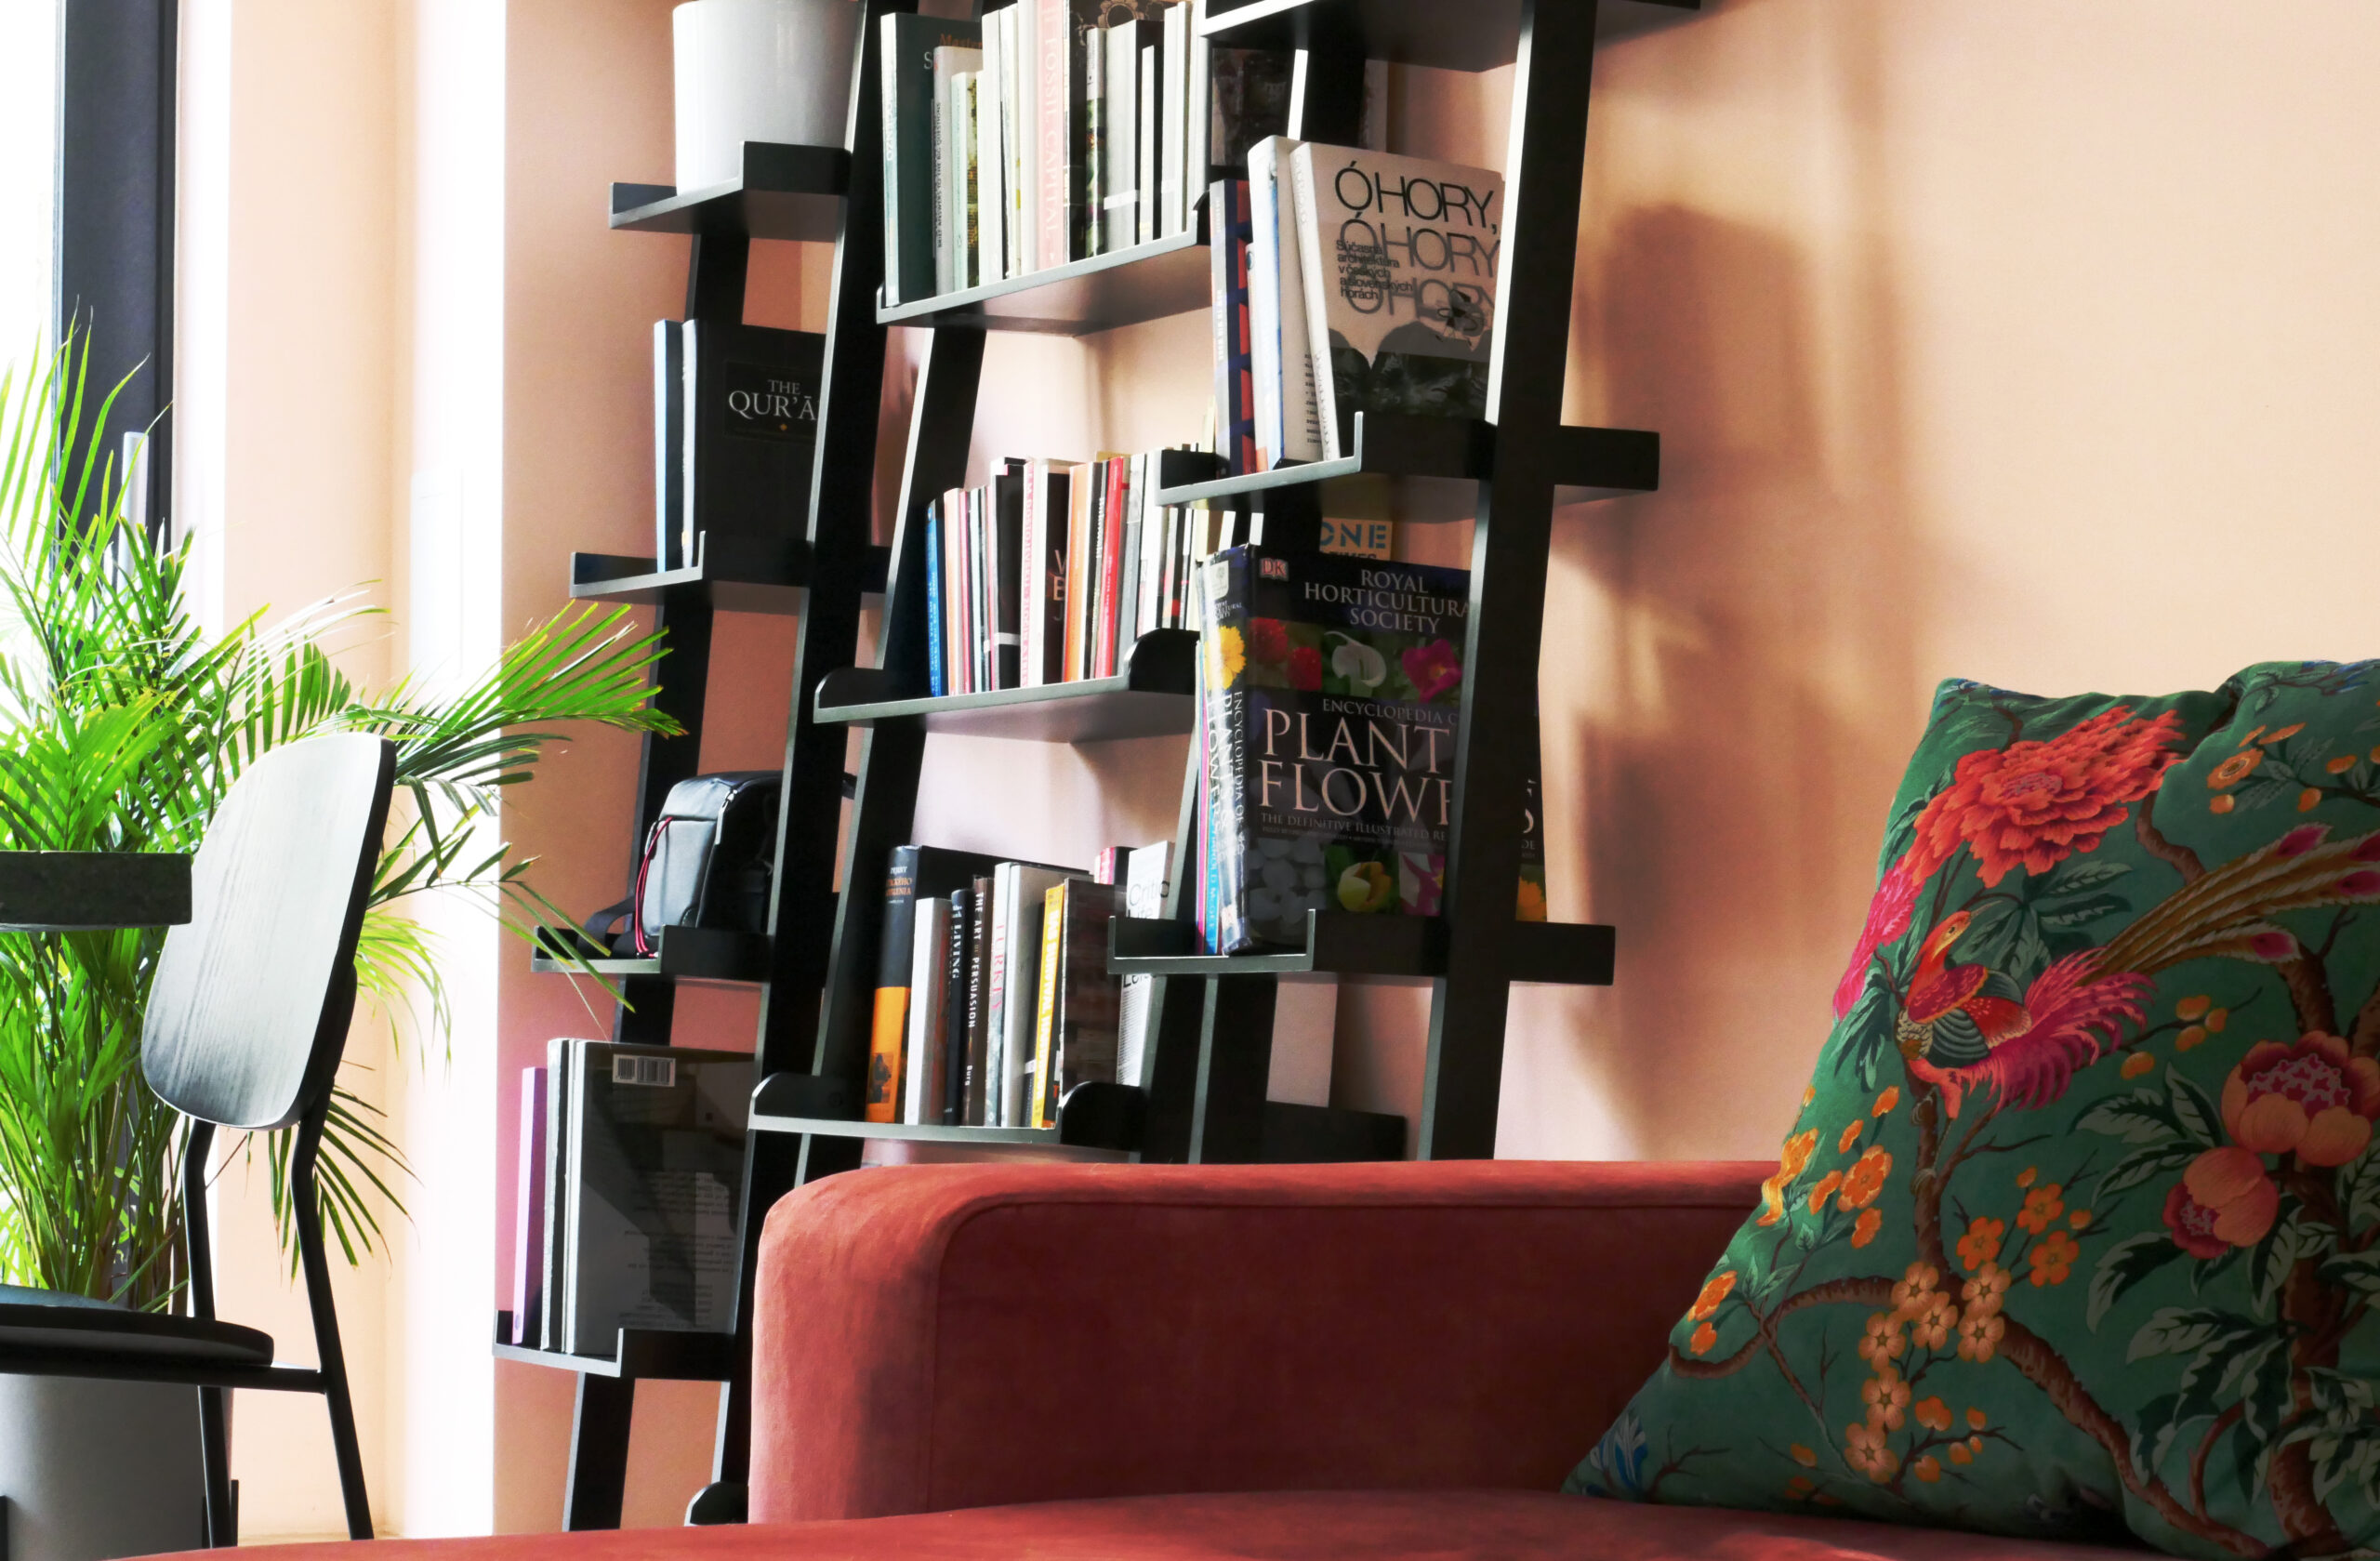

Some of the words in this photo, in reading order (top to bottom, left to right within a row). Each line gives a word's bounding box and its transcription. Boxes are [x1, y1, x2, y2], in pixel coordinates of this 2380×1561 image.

[1046, 130, 1057, 238] CAPITAL
[767, 379, 800, 394] THE
[1320, 521, 1387, 549] ONE
[1261, 558, 1287, 577] DK
[1361, 569, 1429, 594] ROYAL
[1350, 607, 1440, 634] SOCIETY
[1322, 698, 1443, 723] ENCYCLOPEDIA
[1219, 694, 1234, 799] PLANTS
[1234, 692, 1244, 800] ENCYCLOPEDIA
[1261, 813, 1283, 825] THE
[1288, 814, 1351, 831] DEFINITIVE
[1356, 823, 1429, 840] ILLUSTRATED
[974, 892, 984, 912] THE
[973, 919, 982, 940] ART
[952, 924, 962, 979] LIVING
[968, 957, 980, 1028] PERSUASION
